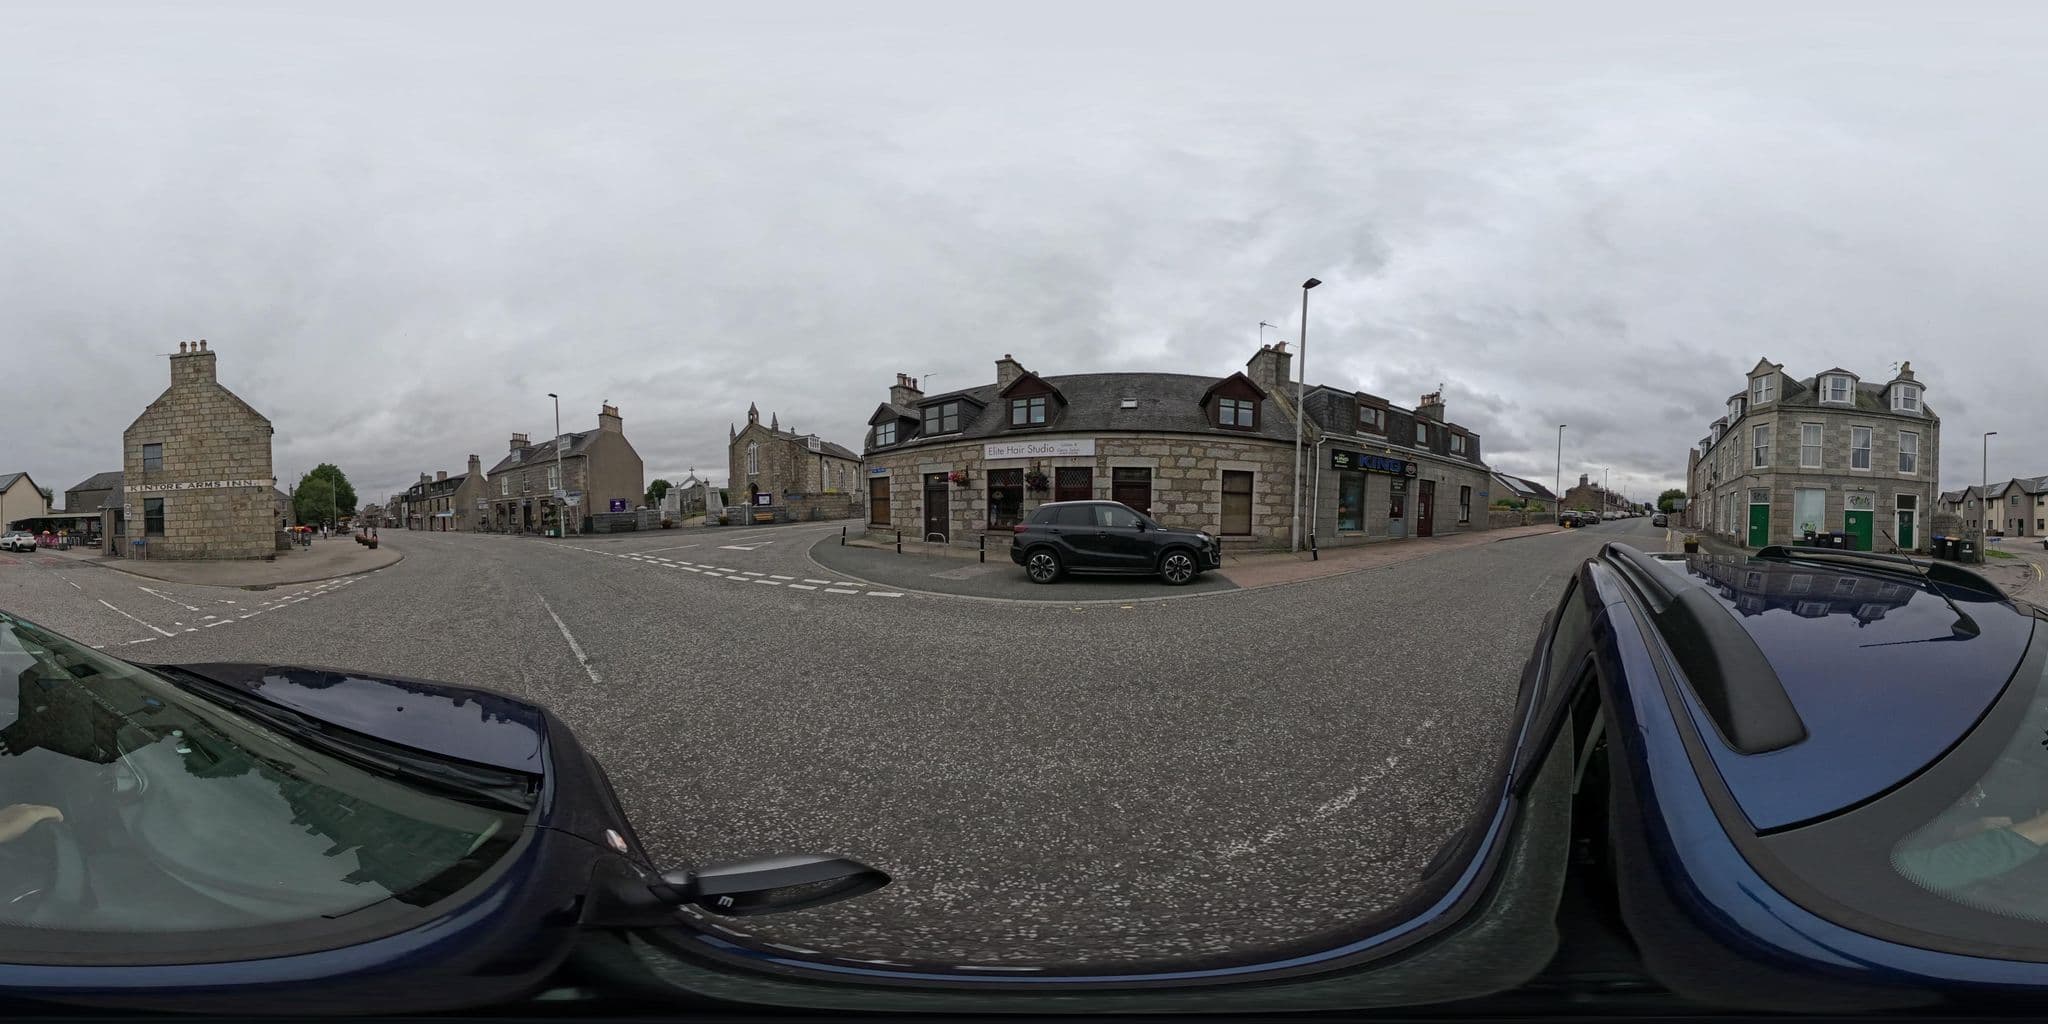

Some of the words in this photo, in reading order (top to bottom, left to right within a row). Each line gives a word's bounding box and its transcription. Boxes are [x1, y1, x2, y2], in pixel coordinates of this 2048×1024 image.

[989, 447, 1004, 456] Elite
[1007, 445, 1024, 454] Hair
[1027, 443, 1055, 453] Studio
[130, 484, 182, 492] KINTORE
[188, 481, 221, 489] ARMS
